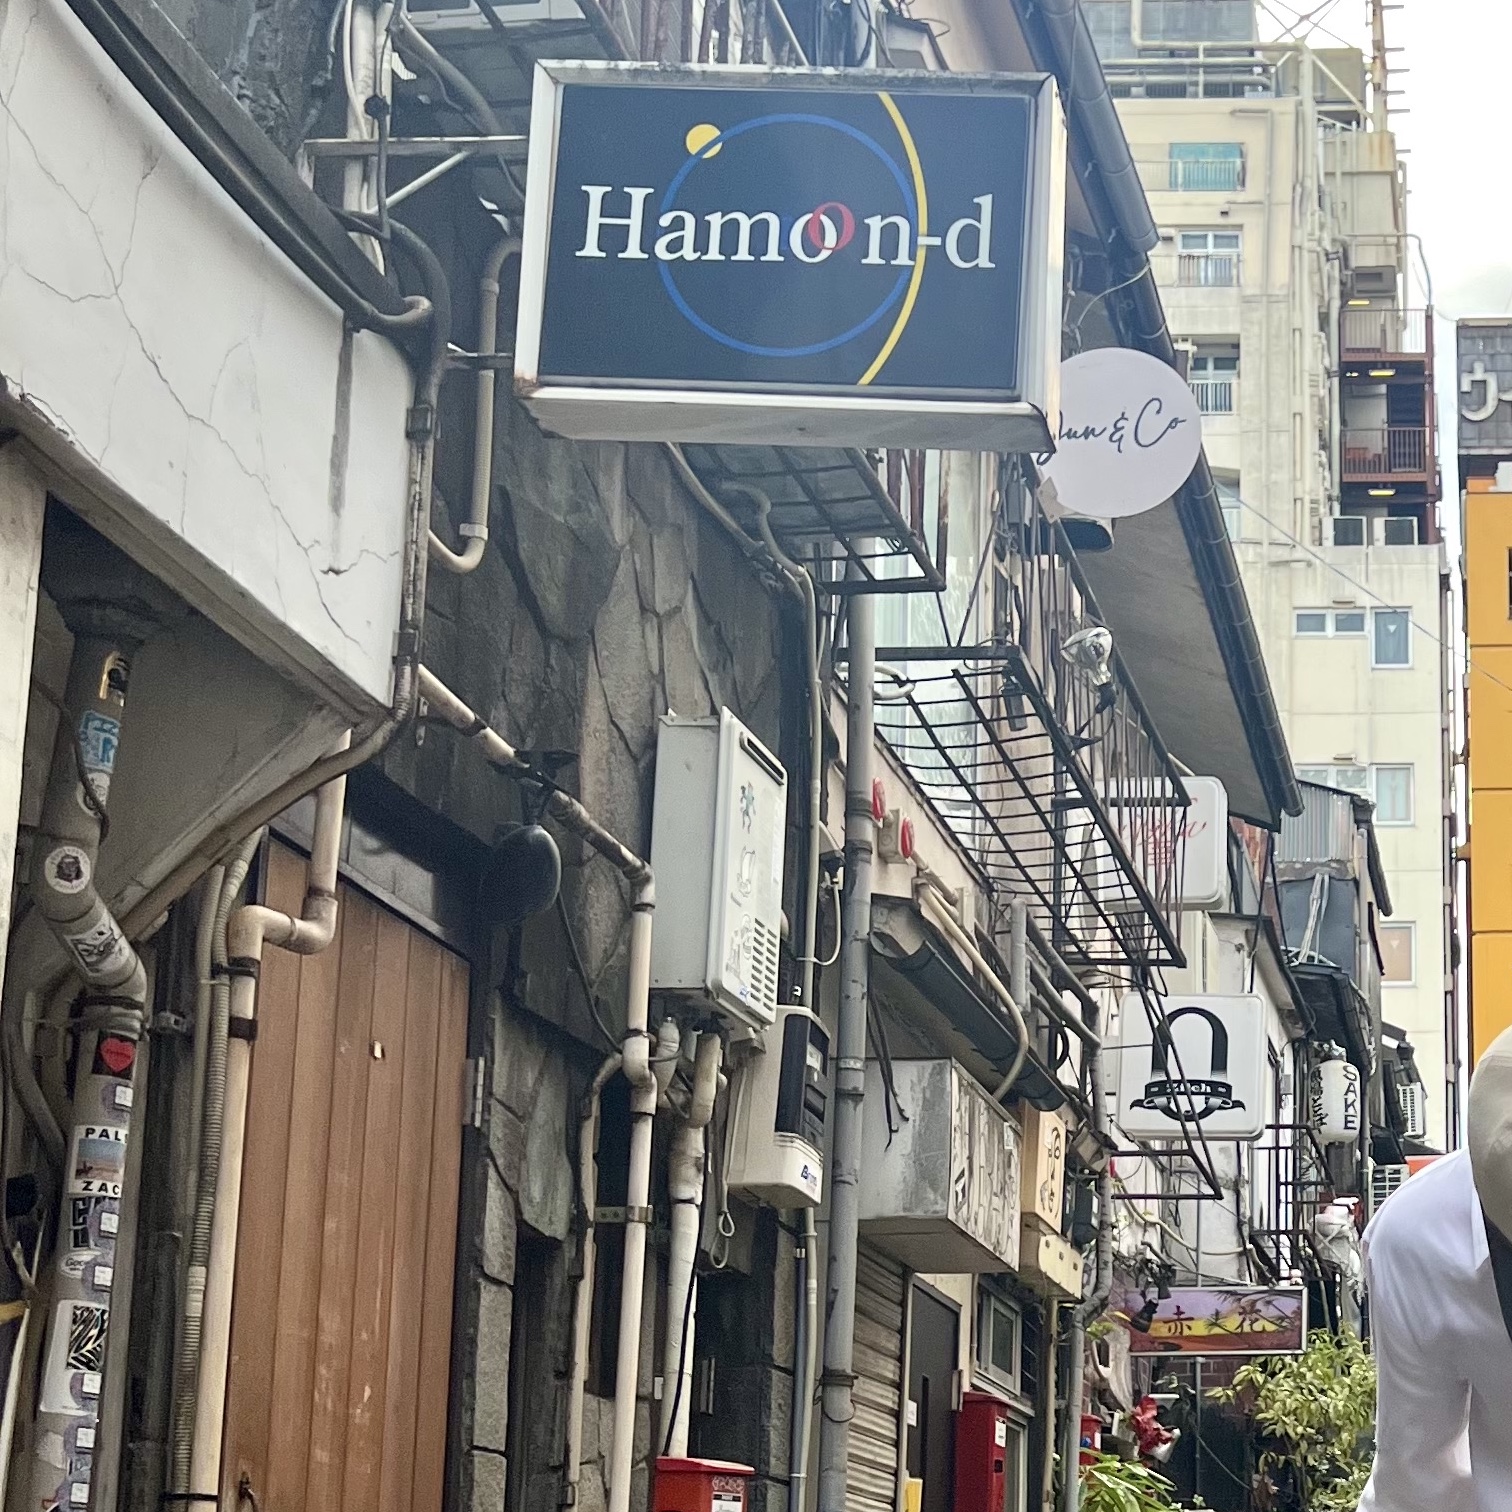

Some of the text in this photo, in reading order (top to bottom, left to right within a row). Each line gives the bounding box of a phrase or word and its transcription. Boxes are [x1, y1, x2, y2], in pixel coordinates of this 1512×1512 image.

[1108, 412, 1129, 454] &
[1134, 397, 1187, 448] Co
[1343, 1065, 1358, 1130] SAKE
